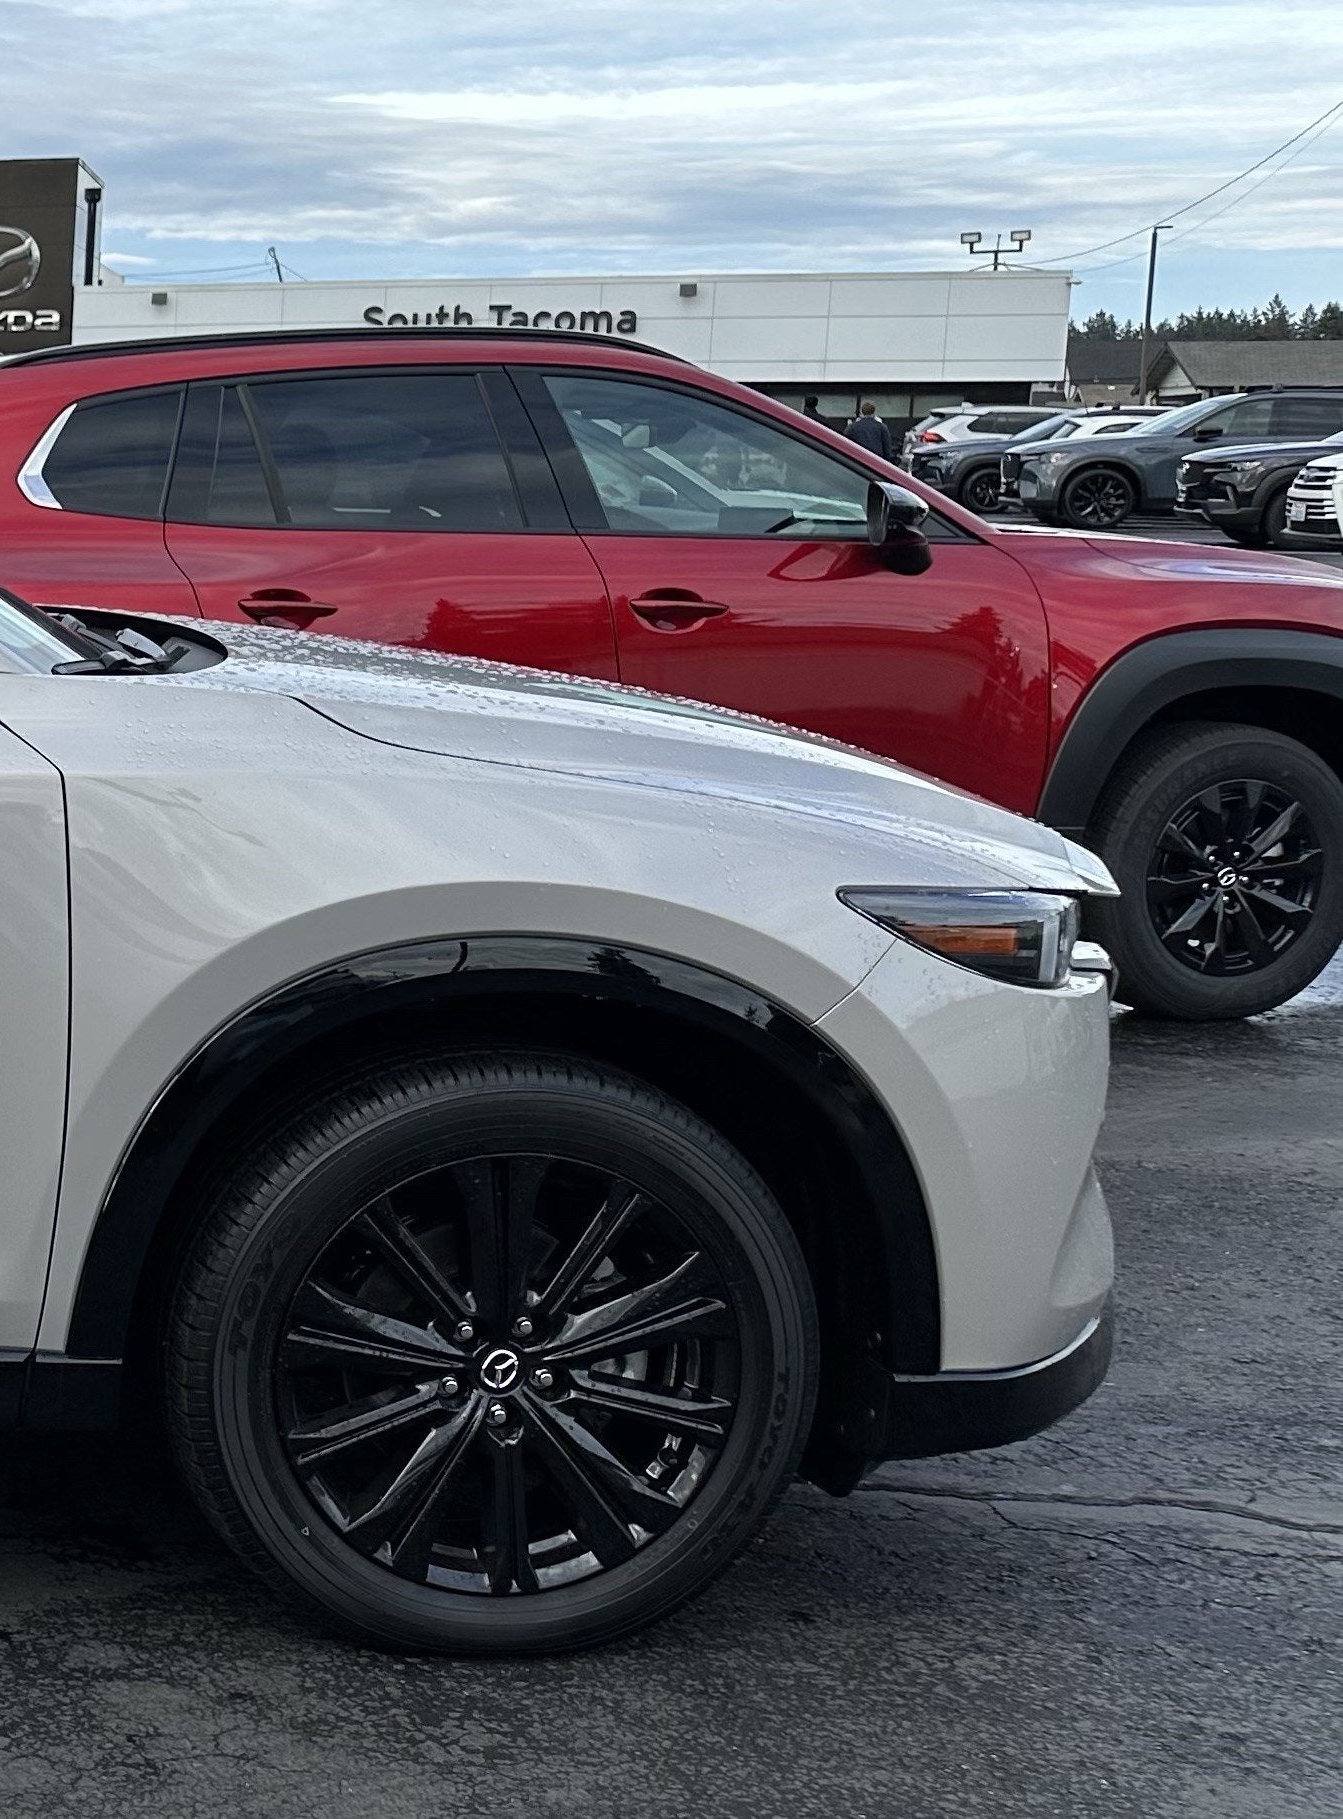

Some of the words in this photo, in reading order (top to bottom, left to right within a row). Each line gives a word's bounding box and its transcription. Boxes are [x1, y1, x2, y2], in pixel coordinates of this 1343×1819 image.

[363, 304, 473, 326] South
[489, 305, 637, 334] Tacoma
[757, 1365, 790, 1472] TOYO
